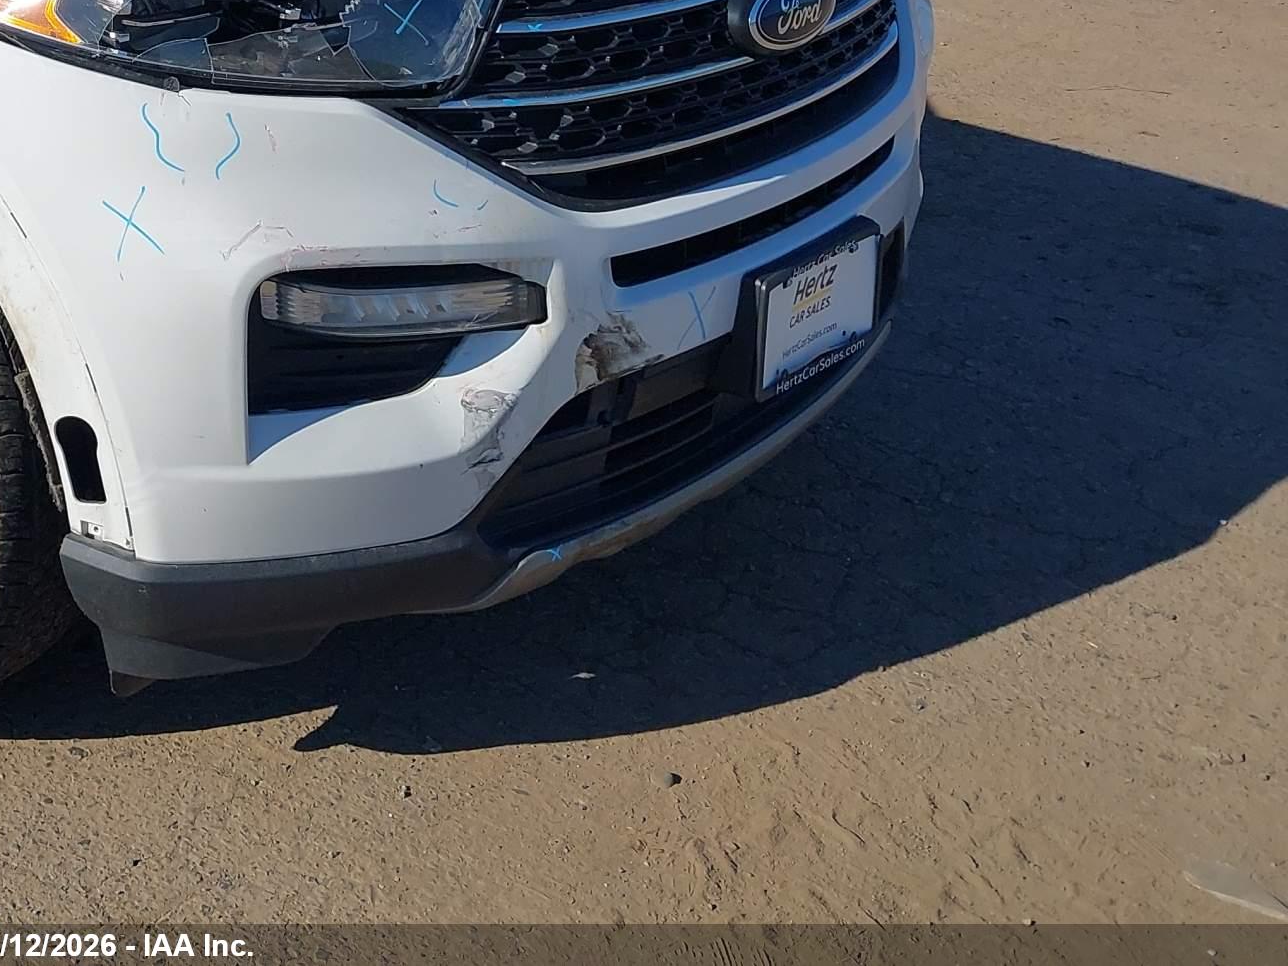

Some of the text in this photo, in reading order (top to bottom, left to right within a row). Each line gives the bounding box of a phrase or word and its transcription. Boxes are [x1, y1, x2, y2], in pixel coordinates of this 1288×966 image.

[793, 264, 838, 305] Hertz
[789, 295, 832, 329] CAR SALES
[776, 338, 866, 395] HertzCarSales.com
